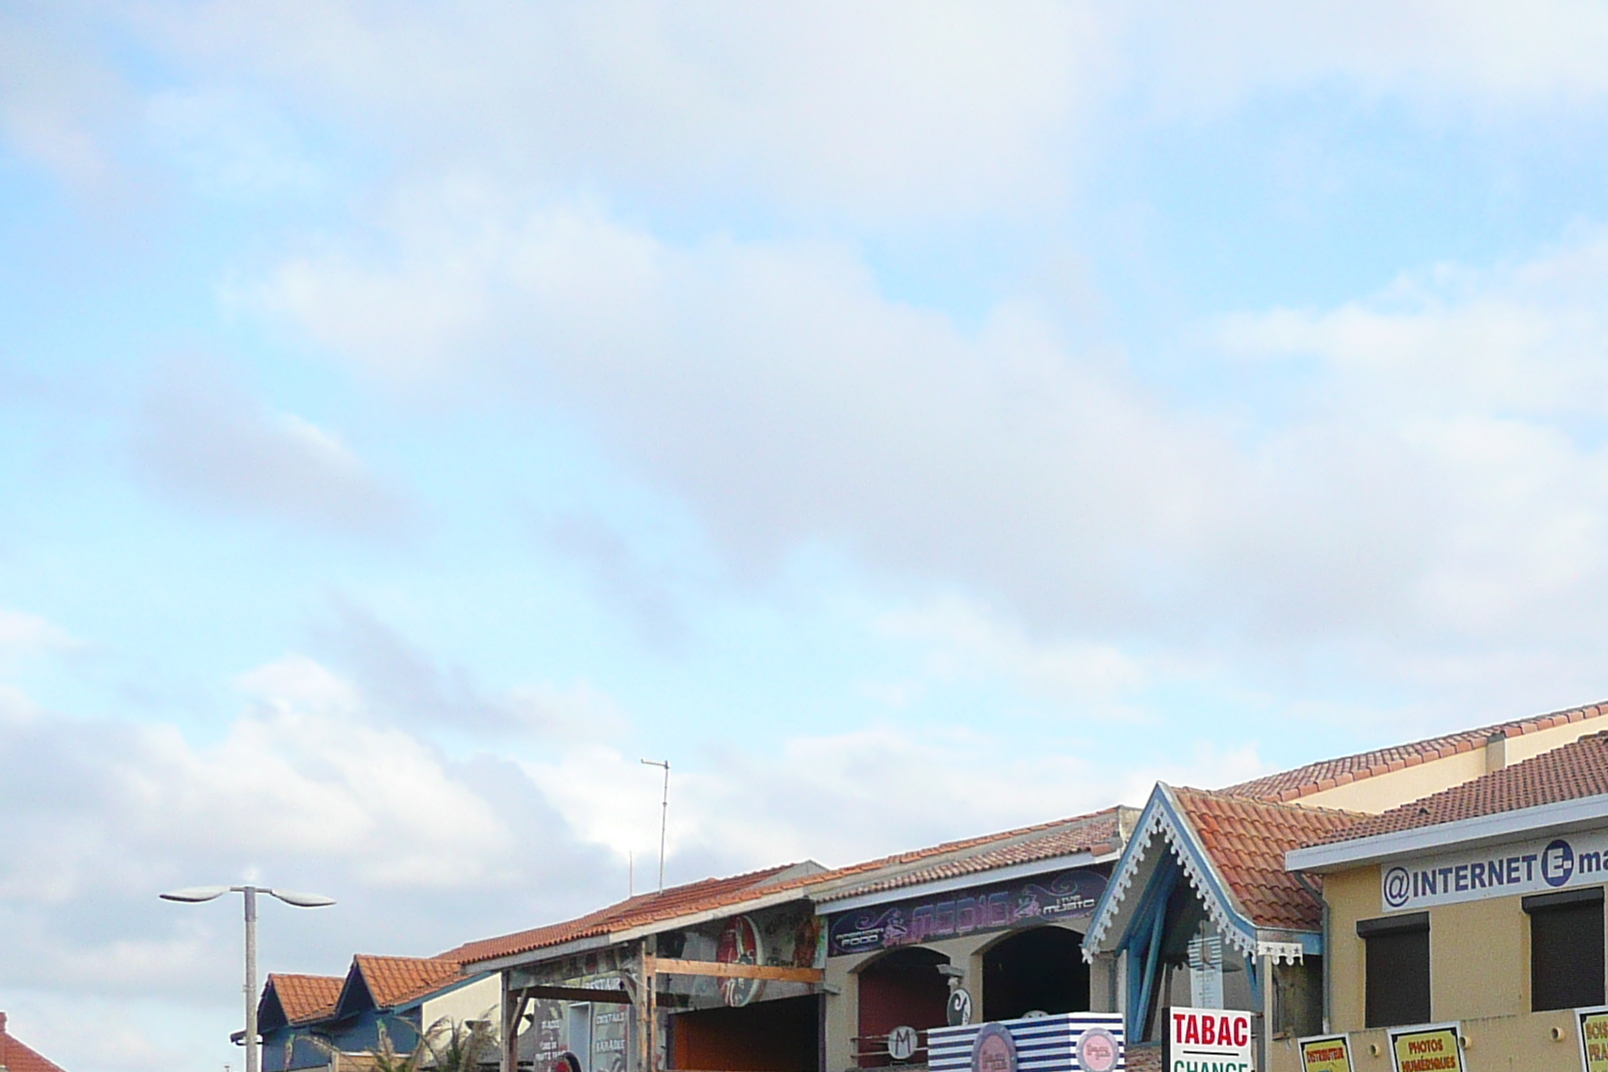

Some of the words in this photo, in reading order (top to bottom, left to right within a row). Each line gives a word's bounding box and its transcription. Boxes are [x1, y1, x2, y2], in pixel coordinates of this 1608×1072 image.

[841, 934, 879, 947] FOOD
[1173, 1013, 1248, 1047] TABAC
[1408, 1038, 1444, 1055] PHOTOS
